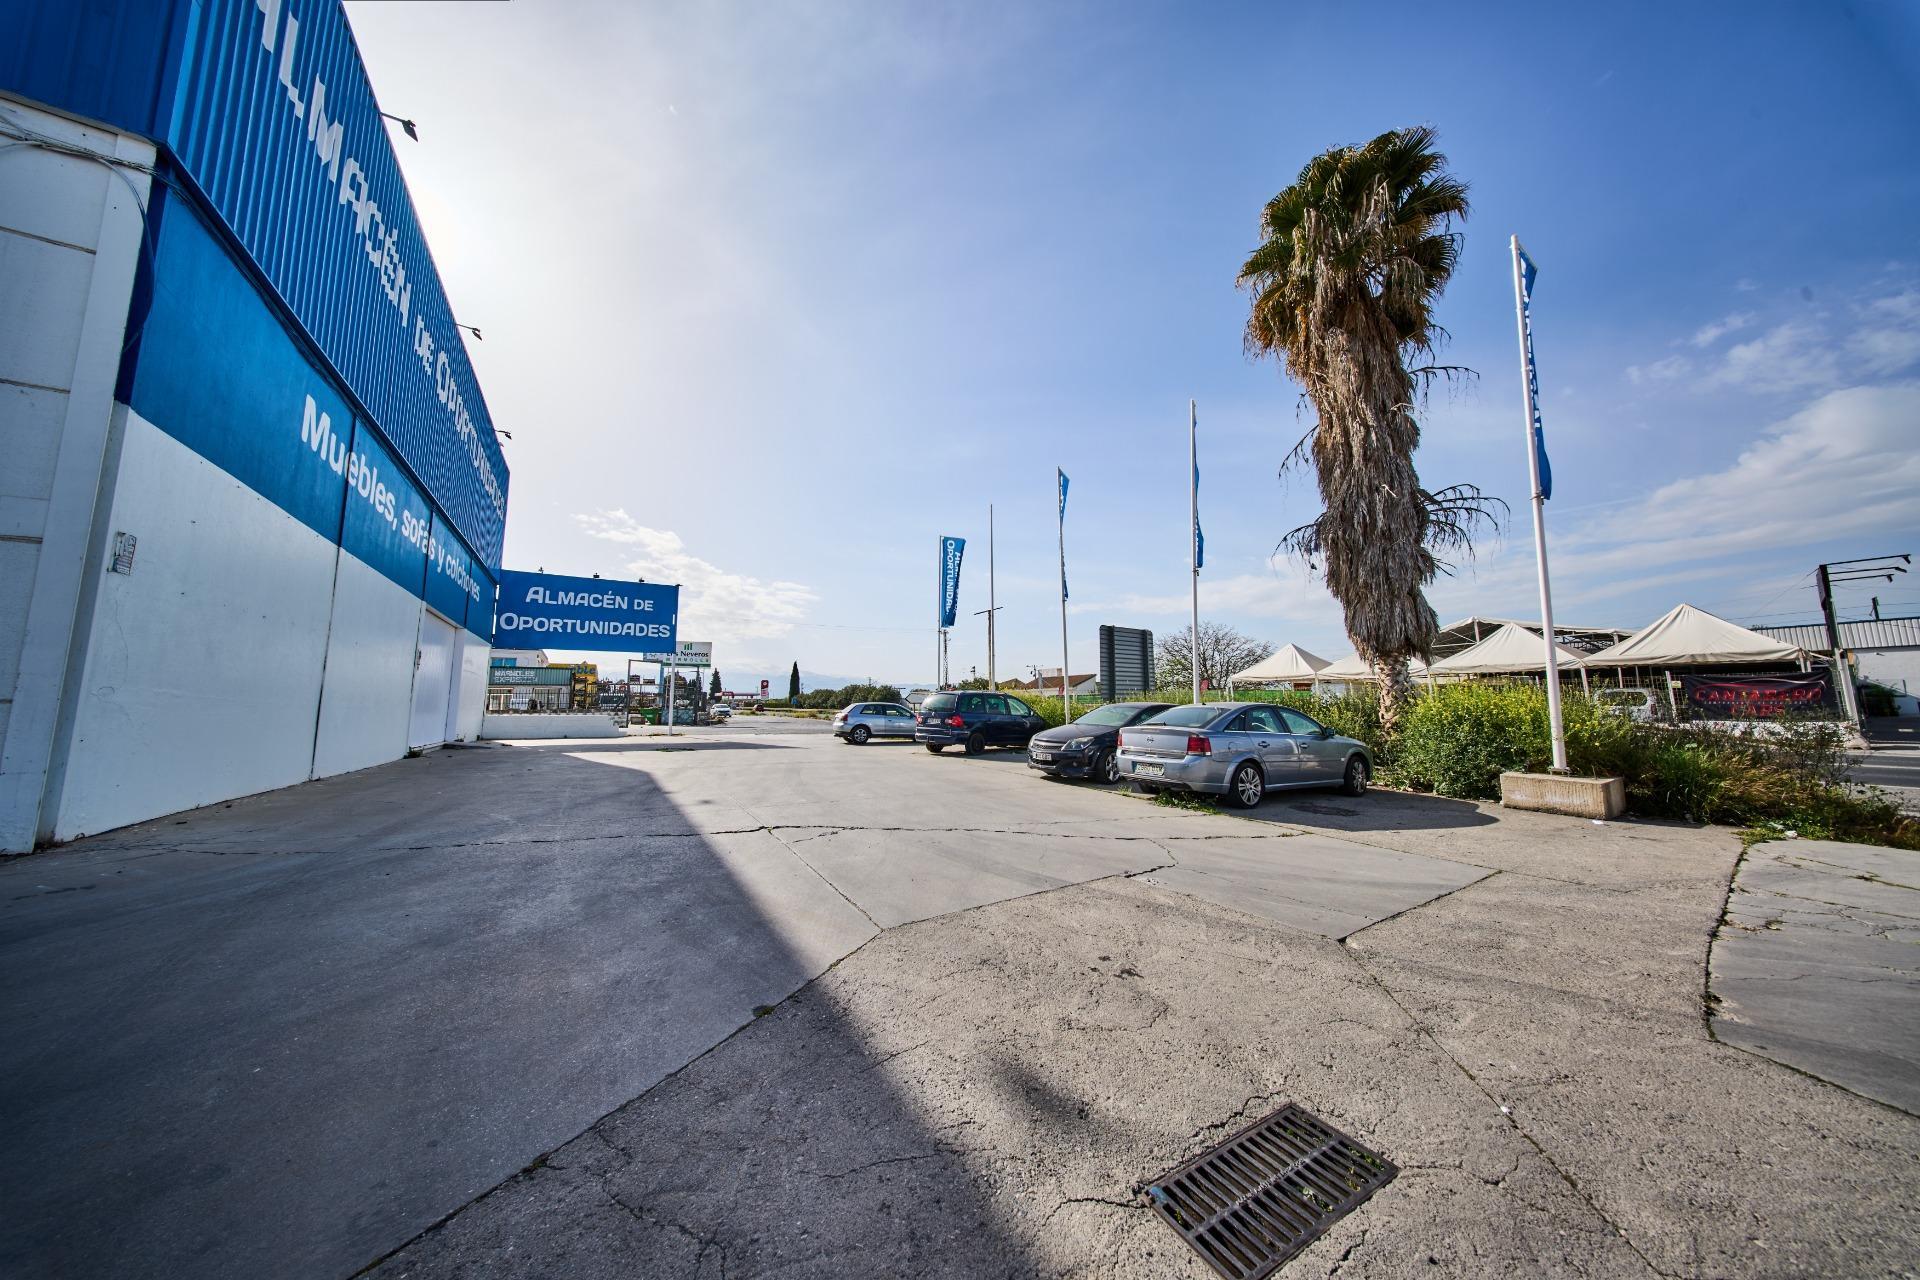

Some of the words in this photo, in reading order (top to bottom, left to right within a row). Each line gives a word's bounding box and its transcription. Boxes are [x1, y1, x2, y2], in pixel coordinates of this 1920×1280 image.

[414, 315, 434, 376] DE
[436, 350, 505, 520] OPORTUNIDADES
[301, 394, 398, 530] Muebles,
[401, 508, 436, 561] sofás
[436, 546, 446, 573] y
[445, 553, 482, 603] colchones
[525, 585, 628, 610] ALMACÉN
[633, 599, 654, 611] DE
[499, 612, 671, 638] OPORTUNIDADES
[680, 650, 709, 658] Neveros
